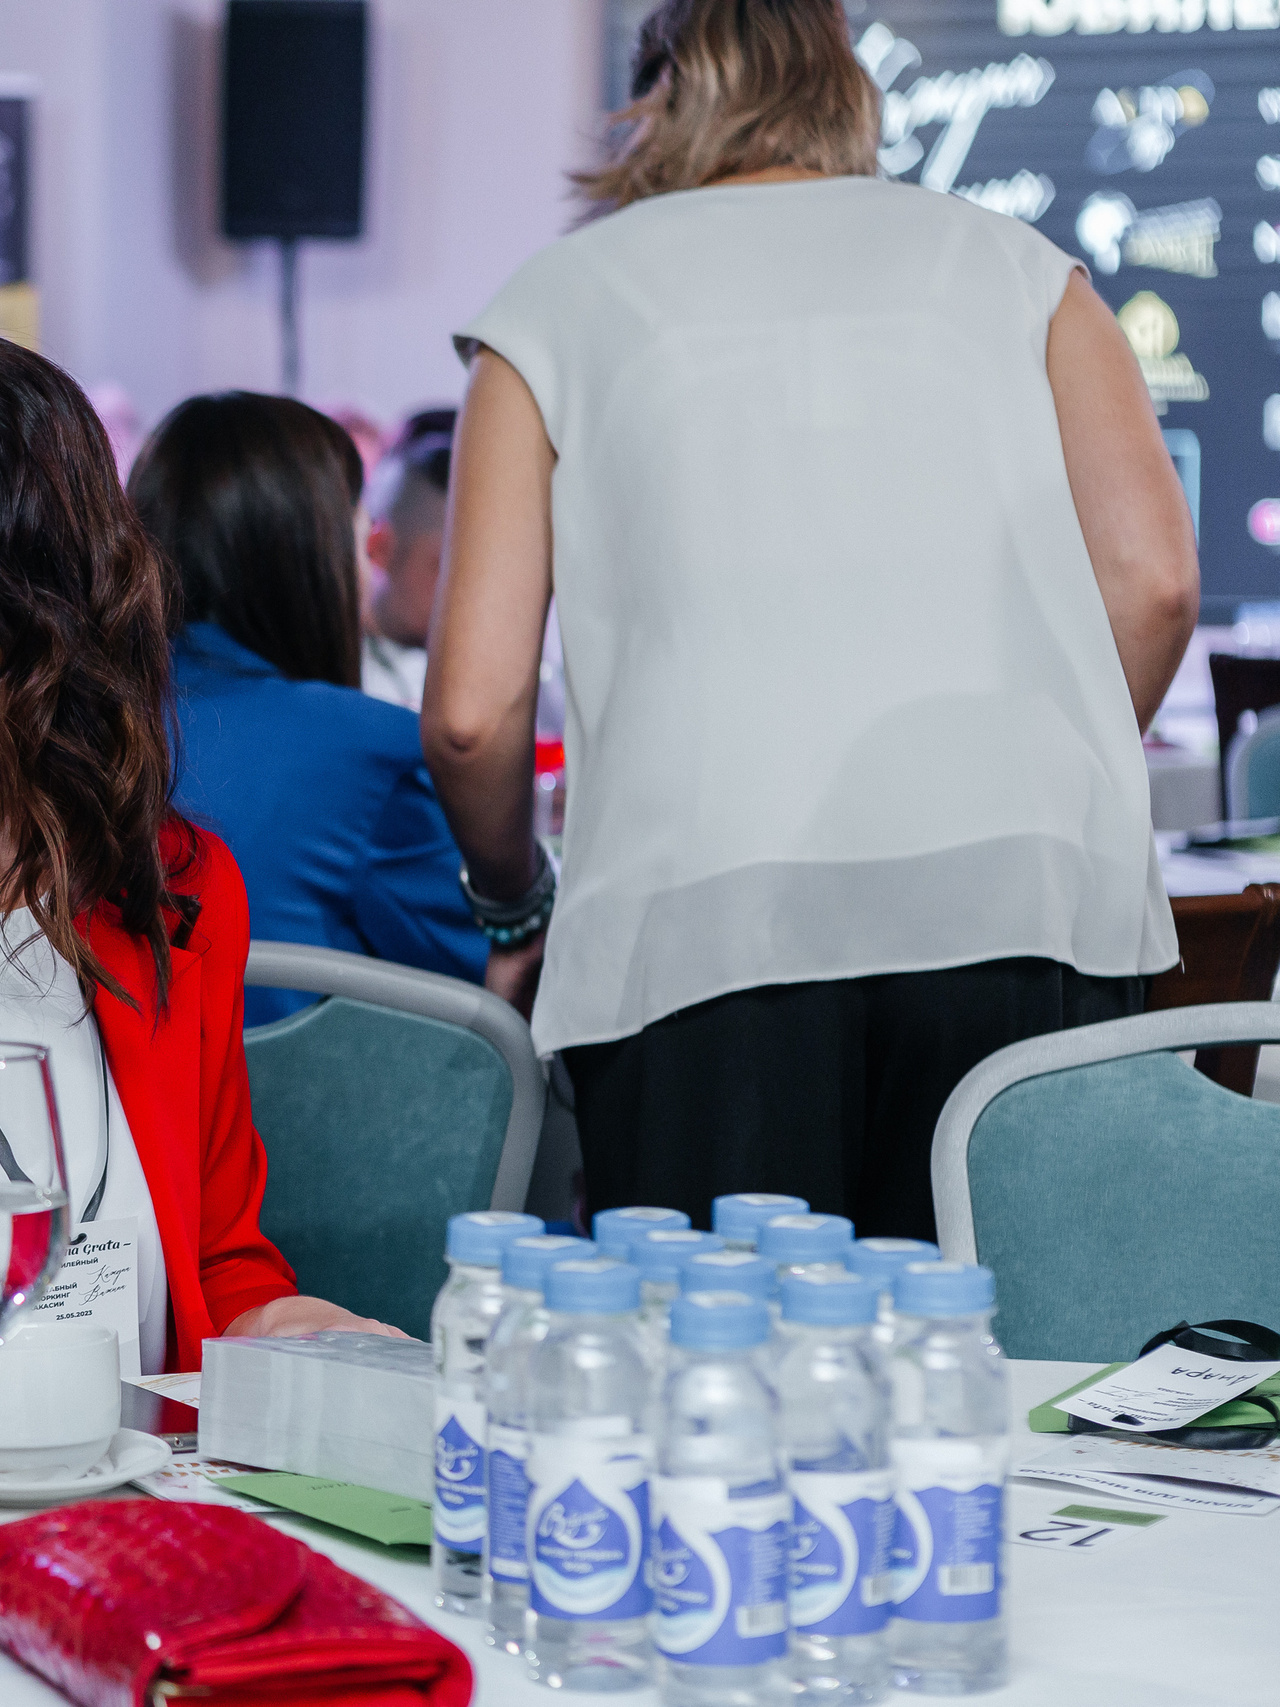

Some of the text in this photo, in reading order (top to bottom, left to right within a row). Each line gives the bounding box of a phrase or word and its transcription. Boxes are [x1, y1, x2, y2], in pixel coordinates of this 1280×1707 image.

[82, 1239, 120, 1255] Grata
[61, 1256, 99, 1268] ИЛЕЙНЫЙ
[40, 1291, 71, 1302] ОРКИНГ
[33, 1300, 65, 1311] АКАСИИ
[56, 1309, 93, 1321] 25.05.2023
[1019, 1520, 1115, 1548] 12
